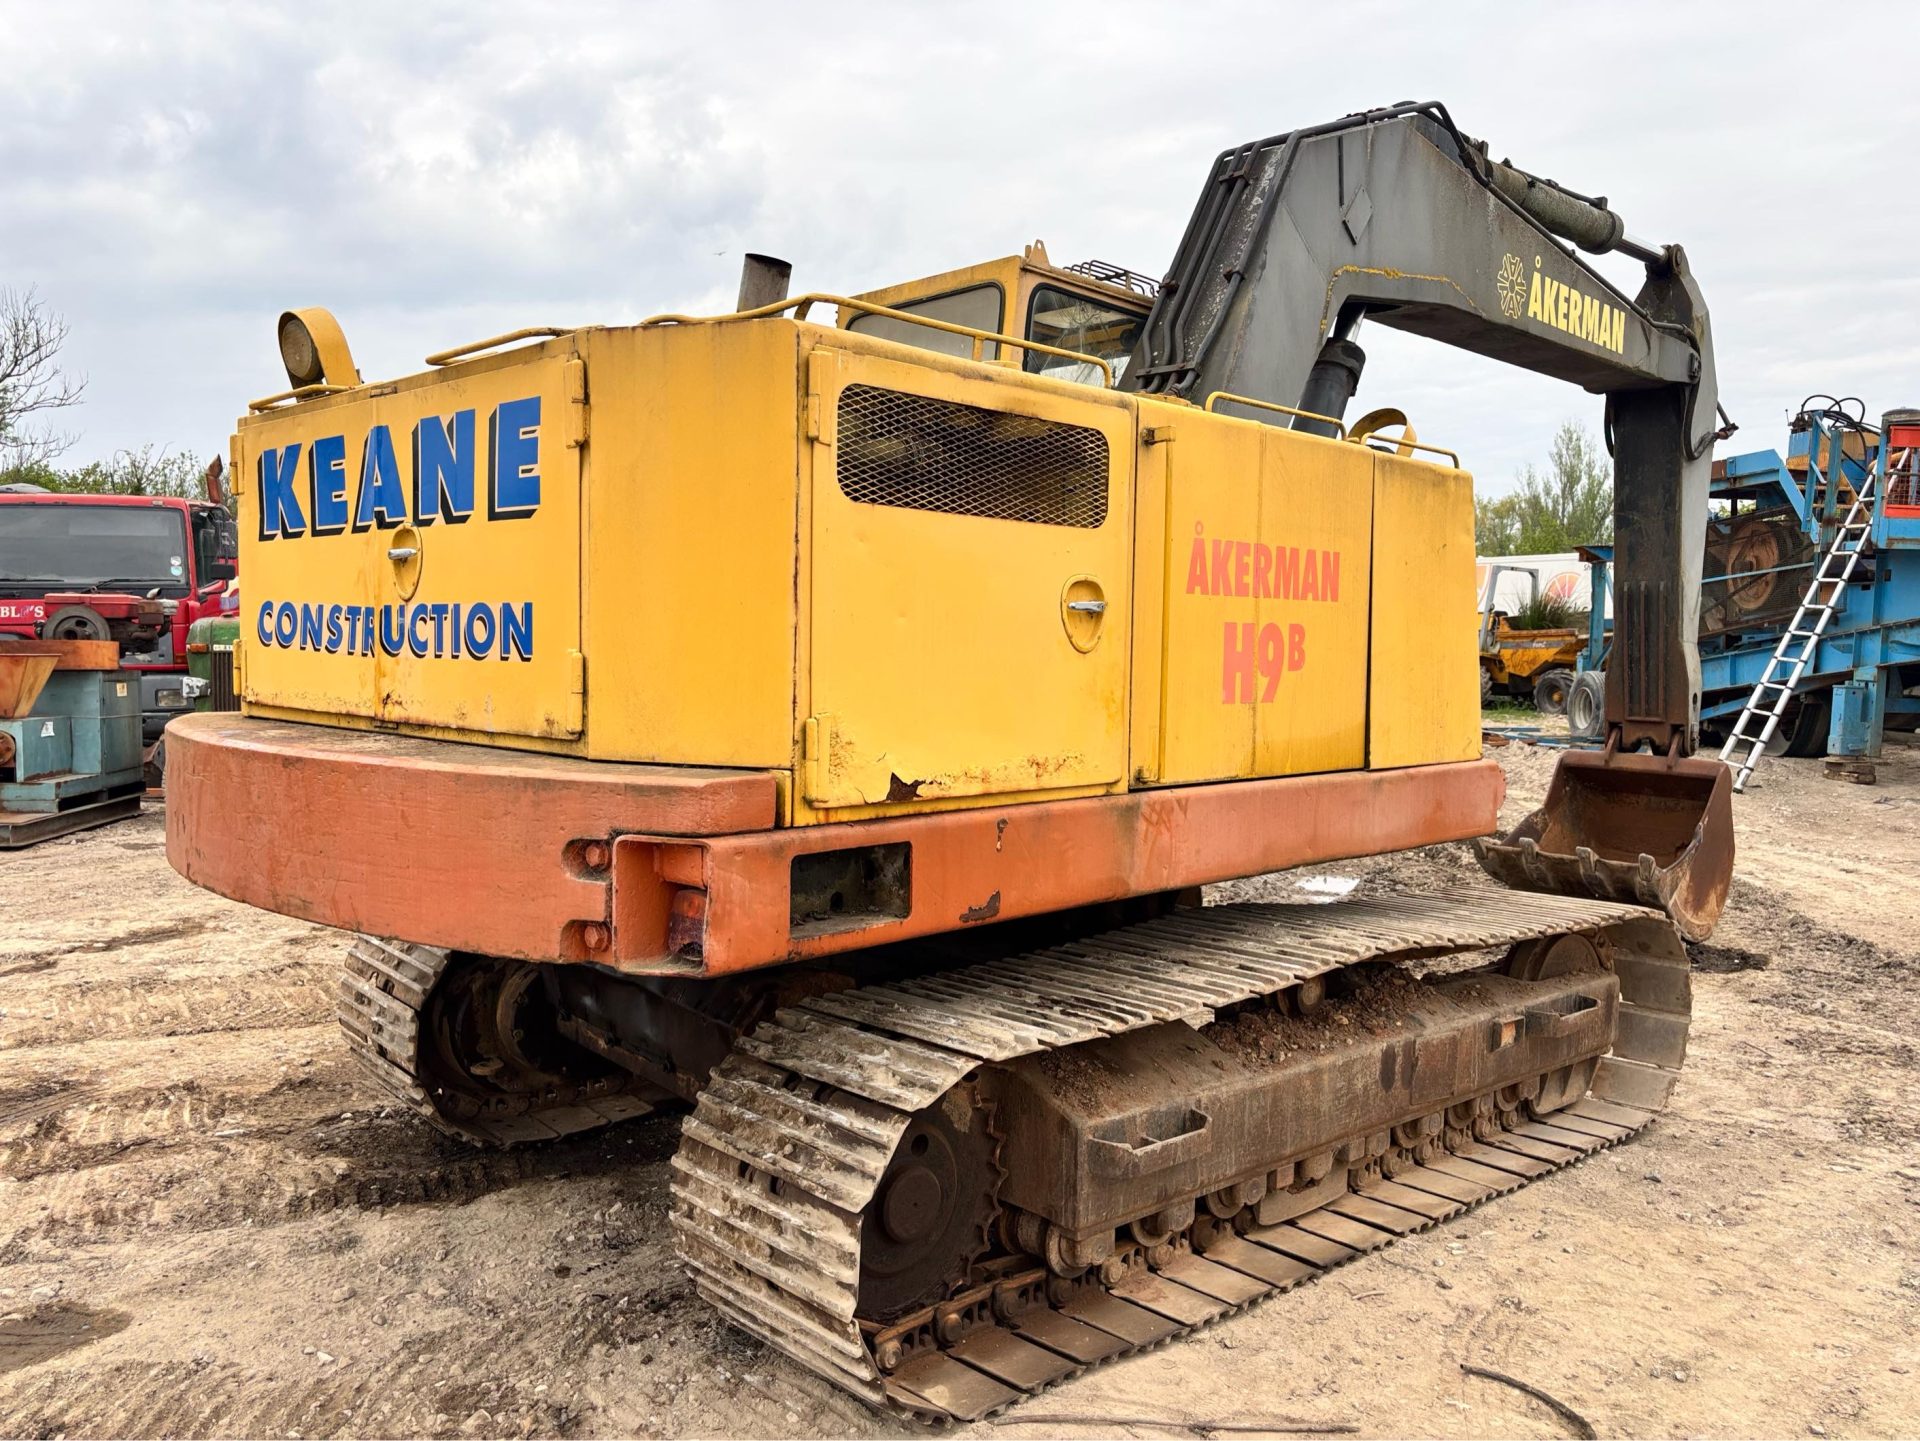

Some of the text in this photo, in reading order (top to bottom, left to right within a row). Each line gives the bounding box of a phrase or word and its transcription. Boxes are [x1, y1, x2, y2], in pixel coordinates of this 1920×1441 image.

[1527, 255, 1626, 355] ÅKERMAN
[257, 396, 541, 542] KEANE
[1186, 520, 1341, 602] ÅKERMAN
[0, 605, 44, 618] BL'S
[257, 600, 533, 662] CONSTRUCTION
[1222, 622, 1306, 704] H9B
